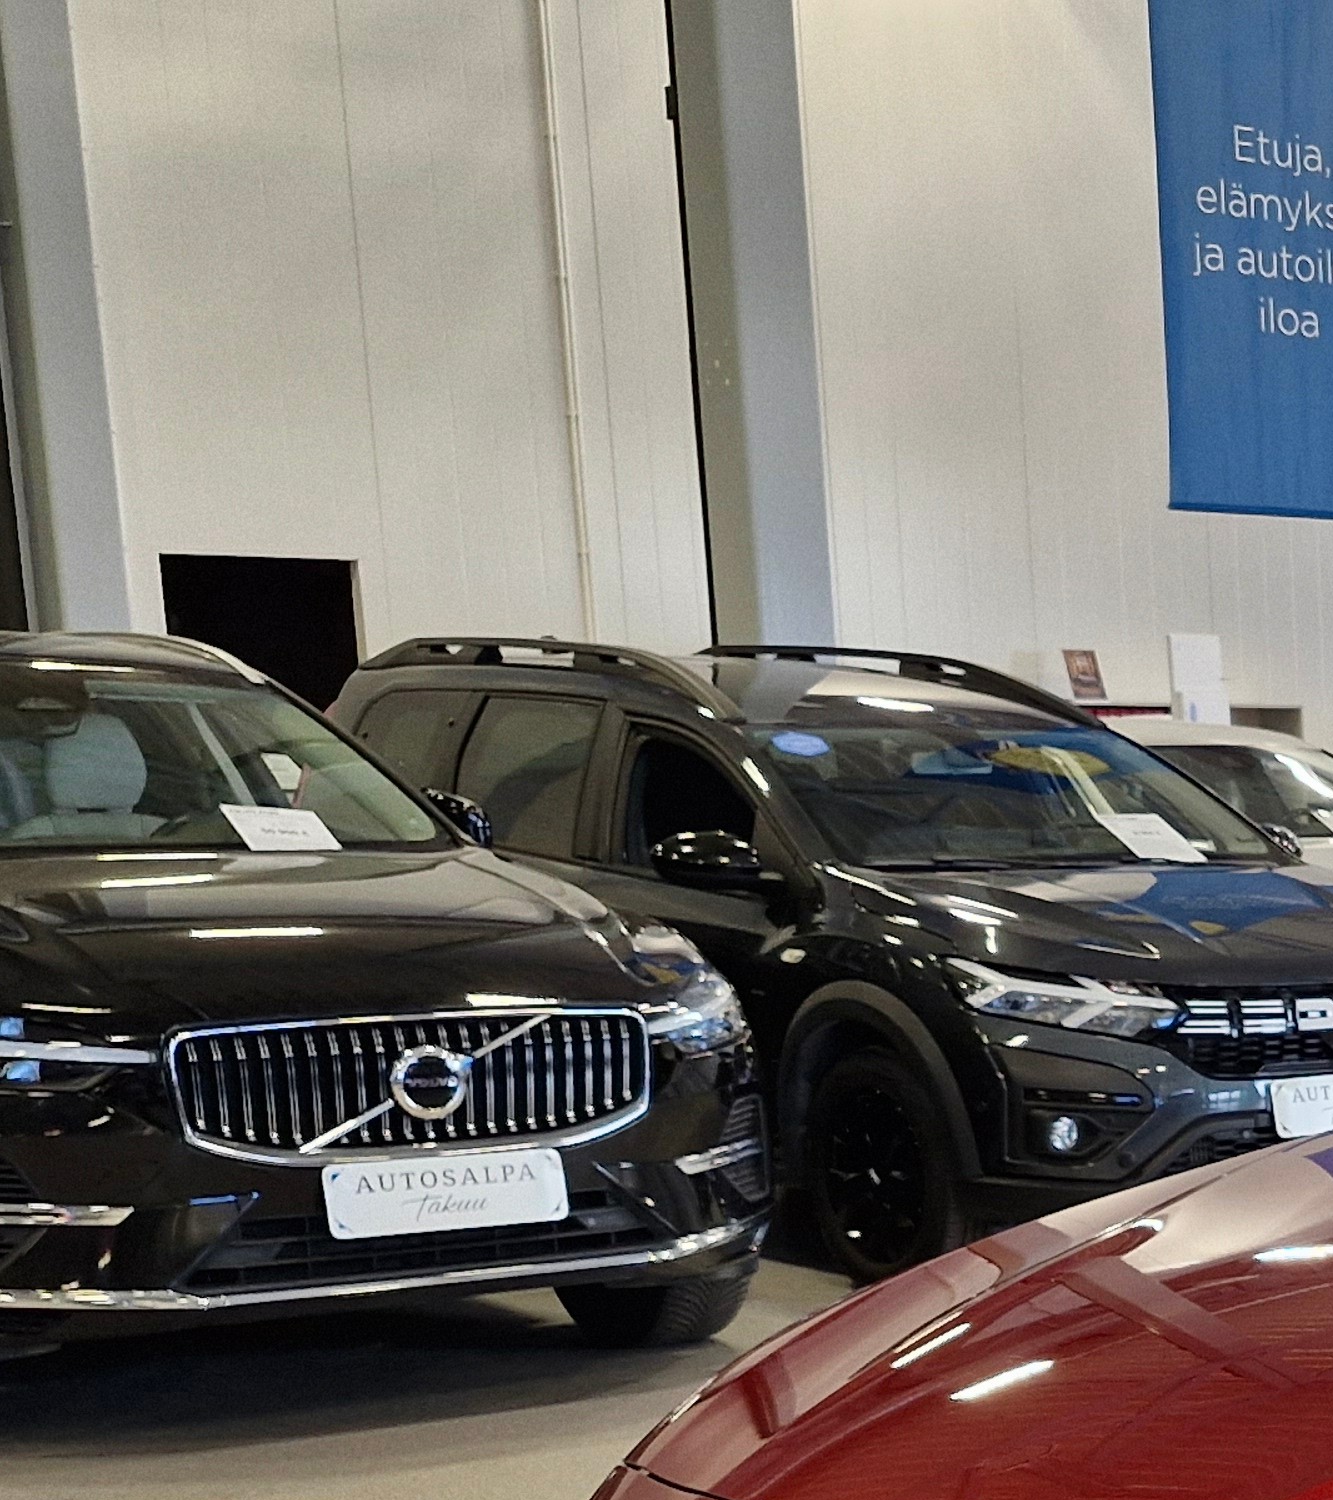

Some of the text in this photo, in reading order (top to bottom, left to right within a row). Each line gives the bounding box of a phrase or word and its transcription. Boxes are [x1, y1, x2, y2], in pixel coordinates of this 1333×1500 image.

[1233, 124, 1331, 178] Etuja,
[1193, 232, 1224, 276] ja
[1258, 297, 1320, 338] iloa
[356, 1163, 537, 1195] AUTOSALPA
[403, 1193, 488, 1222] Takuu
